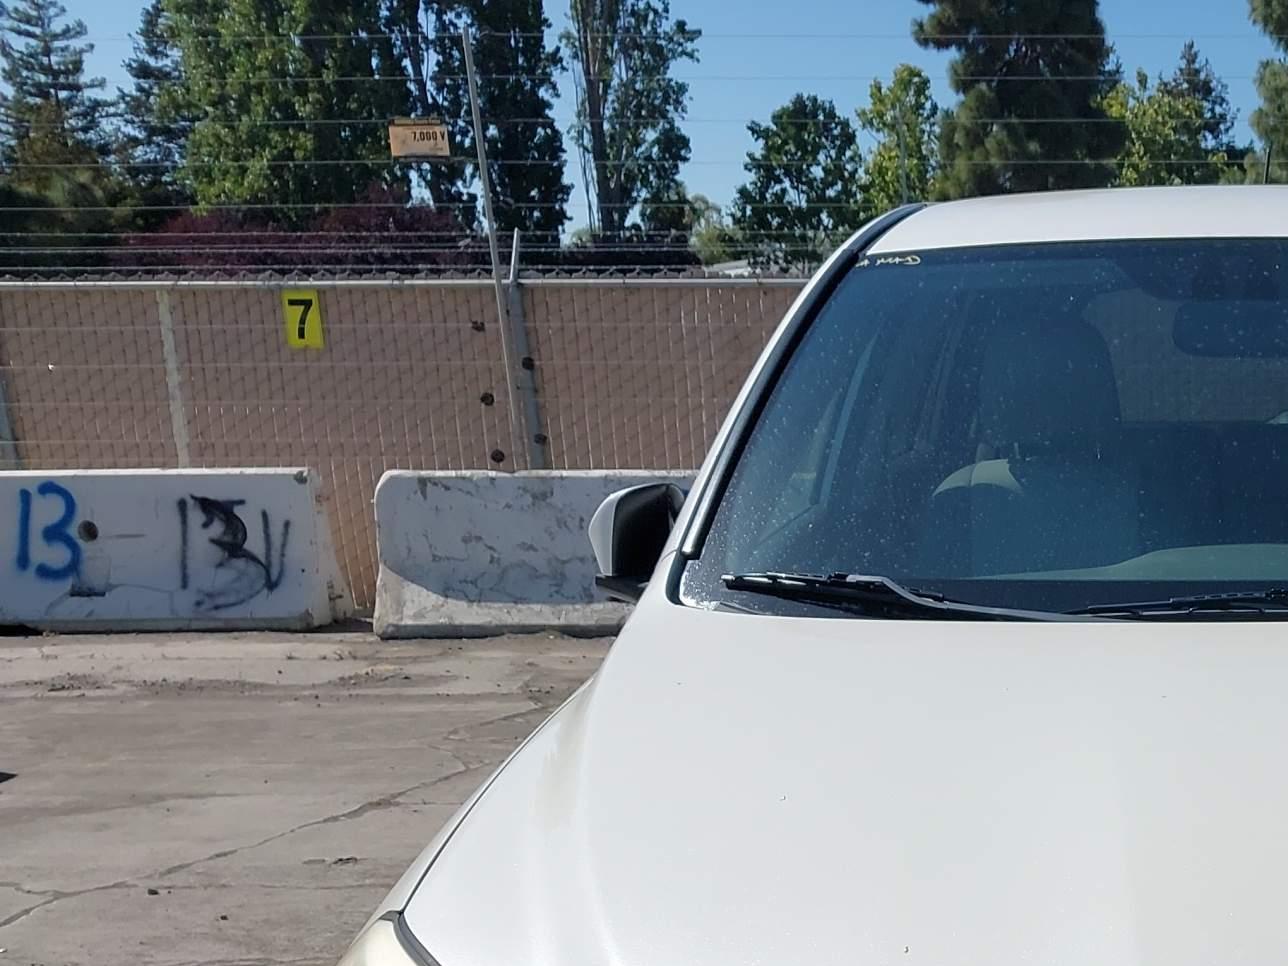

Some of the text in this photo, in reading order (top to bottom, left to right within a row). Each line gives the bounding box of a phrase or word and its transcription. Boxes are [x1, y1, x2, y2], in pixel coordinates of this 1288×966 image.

[411, 131, 445, 142] 7,000 V
[287, 298, 313, 340] 7
[16, 481, 82, 581] 13
